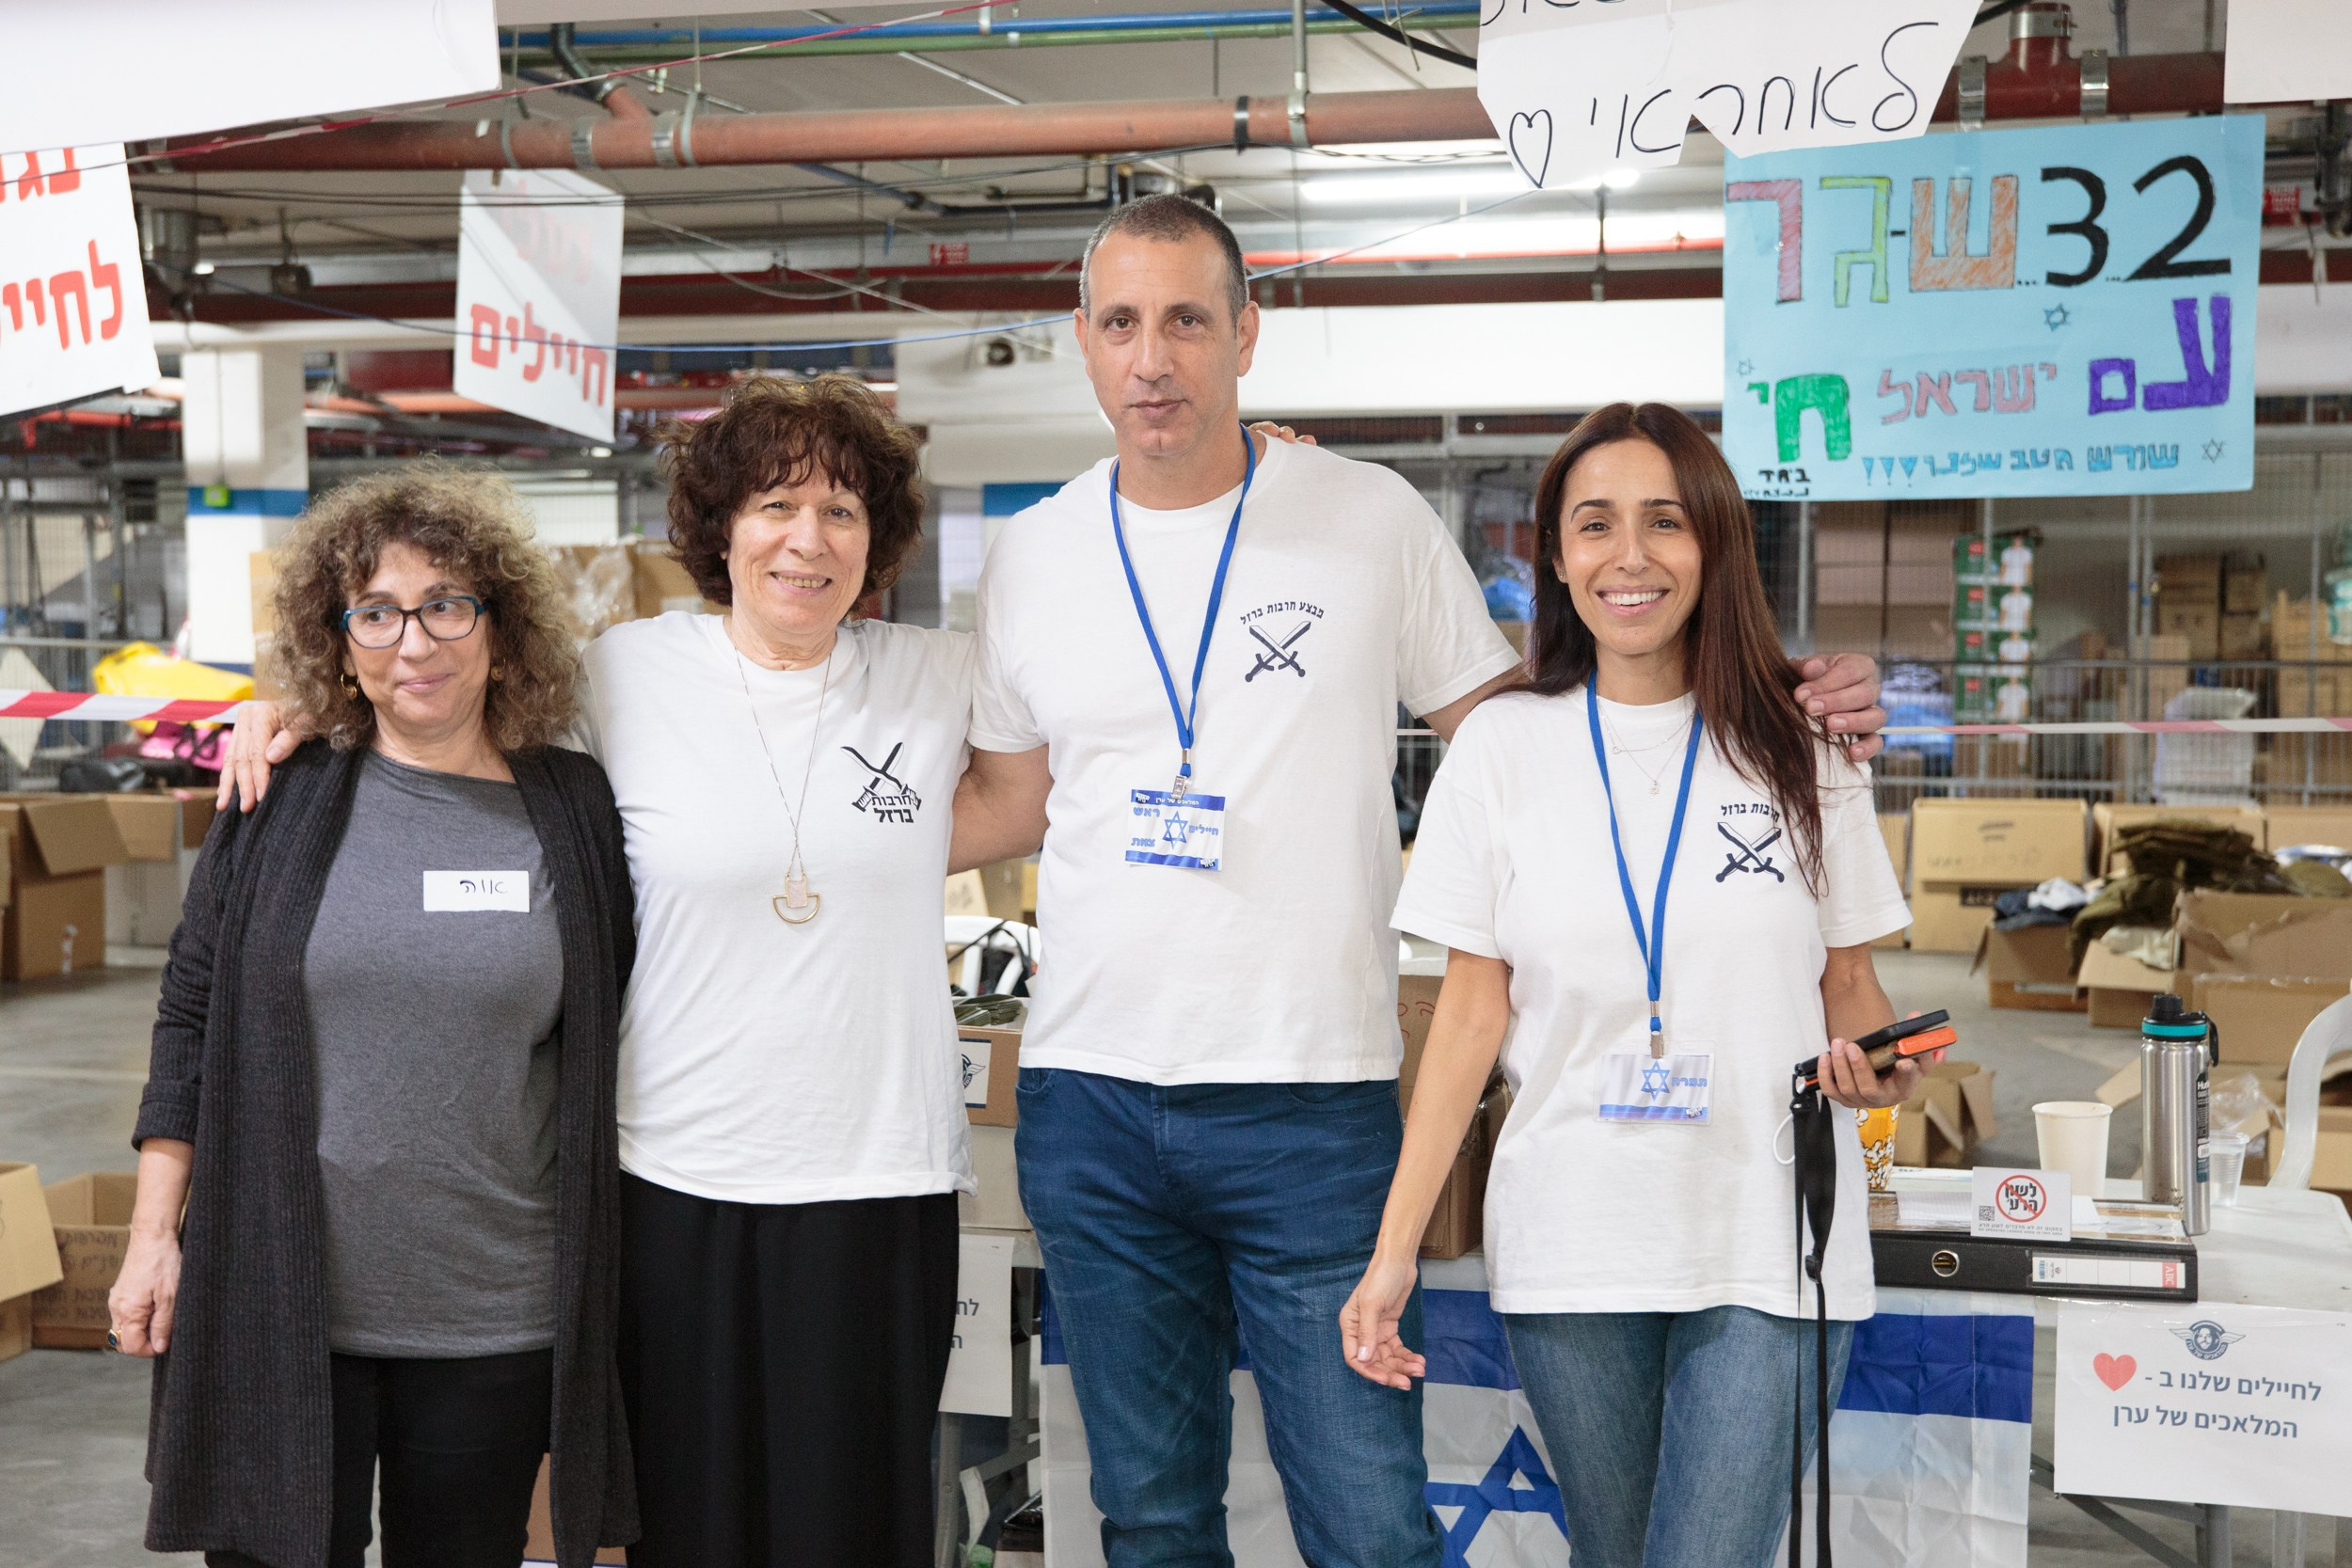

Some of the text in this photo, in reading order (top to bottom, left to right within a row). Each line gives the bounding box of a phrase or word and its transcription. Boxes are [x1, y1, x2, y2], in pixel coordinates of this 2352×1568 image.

[0, 239, 124, 351] לחיי
[469, 300, 609, 407] חיילים
[1747, 294, 2232, 464] עם ישראל חי
[1240, 600, 1325, 625] מבצע חרבות ברזל
[871, 795, 912, 806] חרבות
[1721, 803, 1747, 816] ברזל
[873, 807, 914, 823] ברזל
[1133, 806, 1161, 818] ראש
[1188, 824, 1219, 836] חיילים
[2005, 1182, 2037, 1202] לשון
[2009, 1198, 2038, 1215] הרע
[2164, 1265, 2174, 1285] ABC
[956, 1298, 979, 1316] לח
[2159, 1370, 2174, 1387] ב
[2180, 1370, 2231, 1392] שלנו
[2237, 1376, 2322, 1402] לחיילים
[2113, 1405, 2298, 1438] המלאכים של ערן
